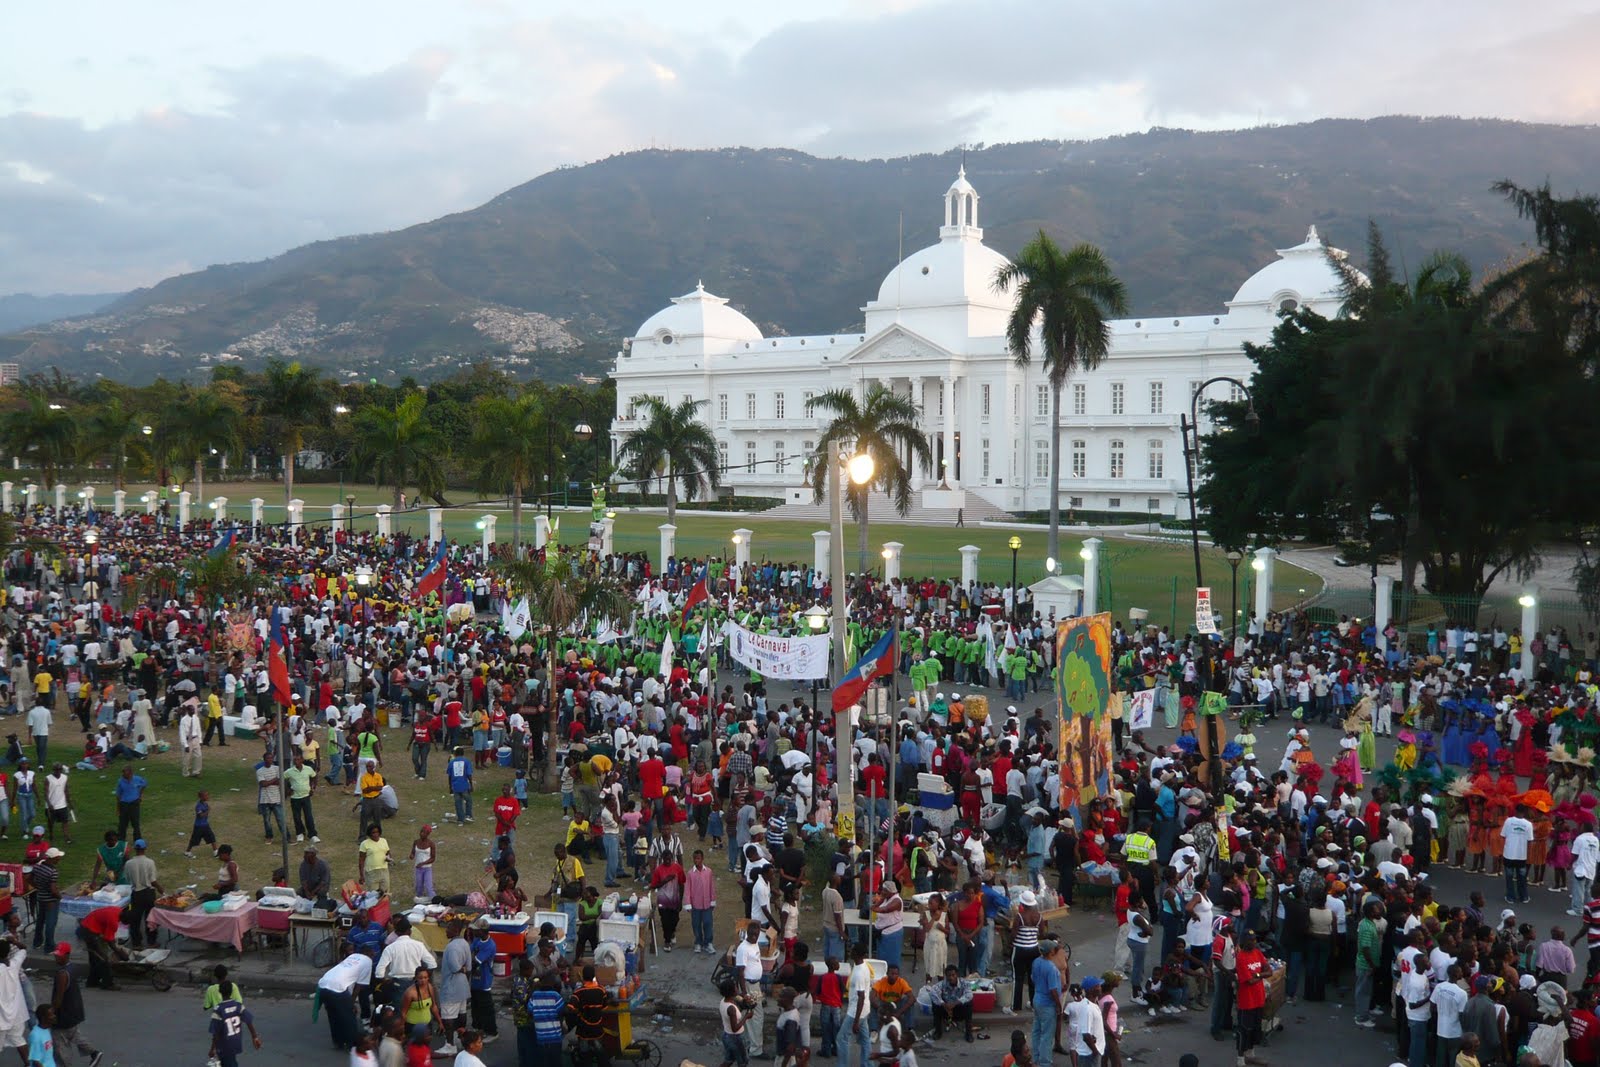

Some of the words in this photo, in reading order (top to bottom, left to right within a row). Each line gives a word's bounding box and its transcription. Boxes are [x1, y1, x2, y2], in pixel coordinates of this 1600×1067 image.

[748, 631, 755, 645] Le
[756, 634, 790, 653] Carnaval
[1130, 850, 1145, 859] POLICE
[224, 1015, 241, 1036] 12
